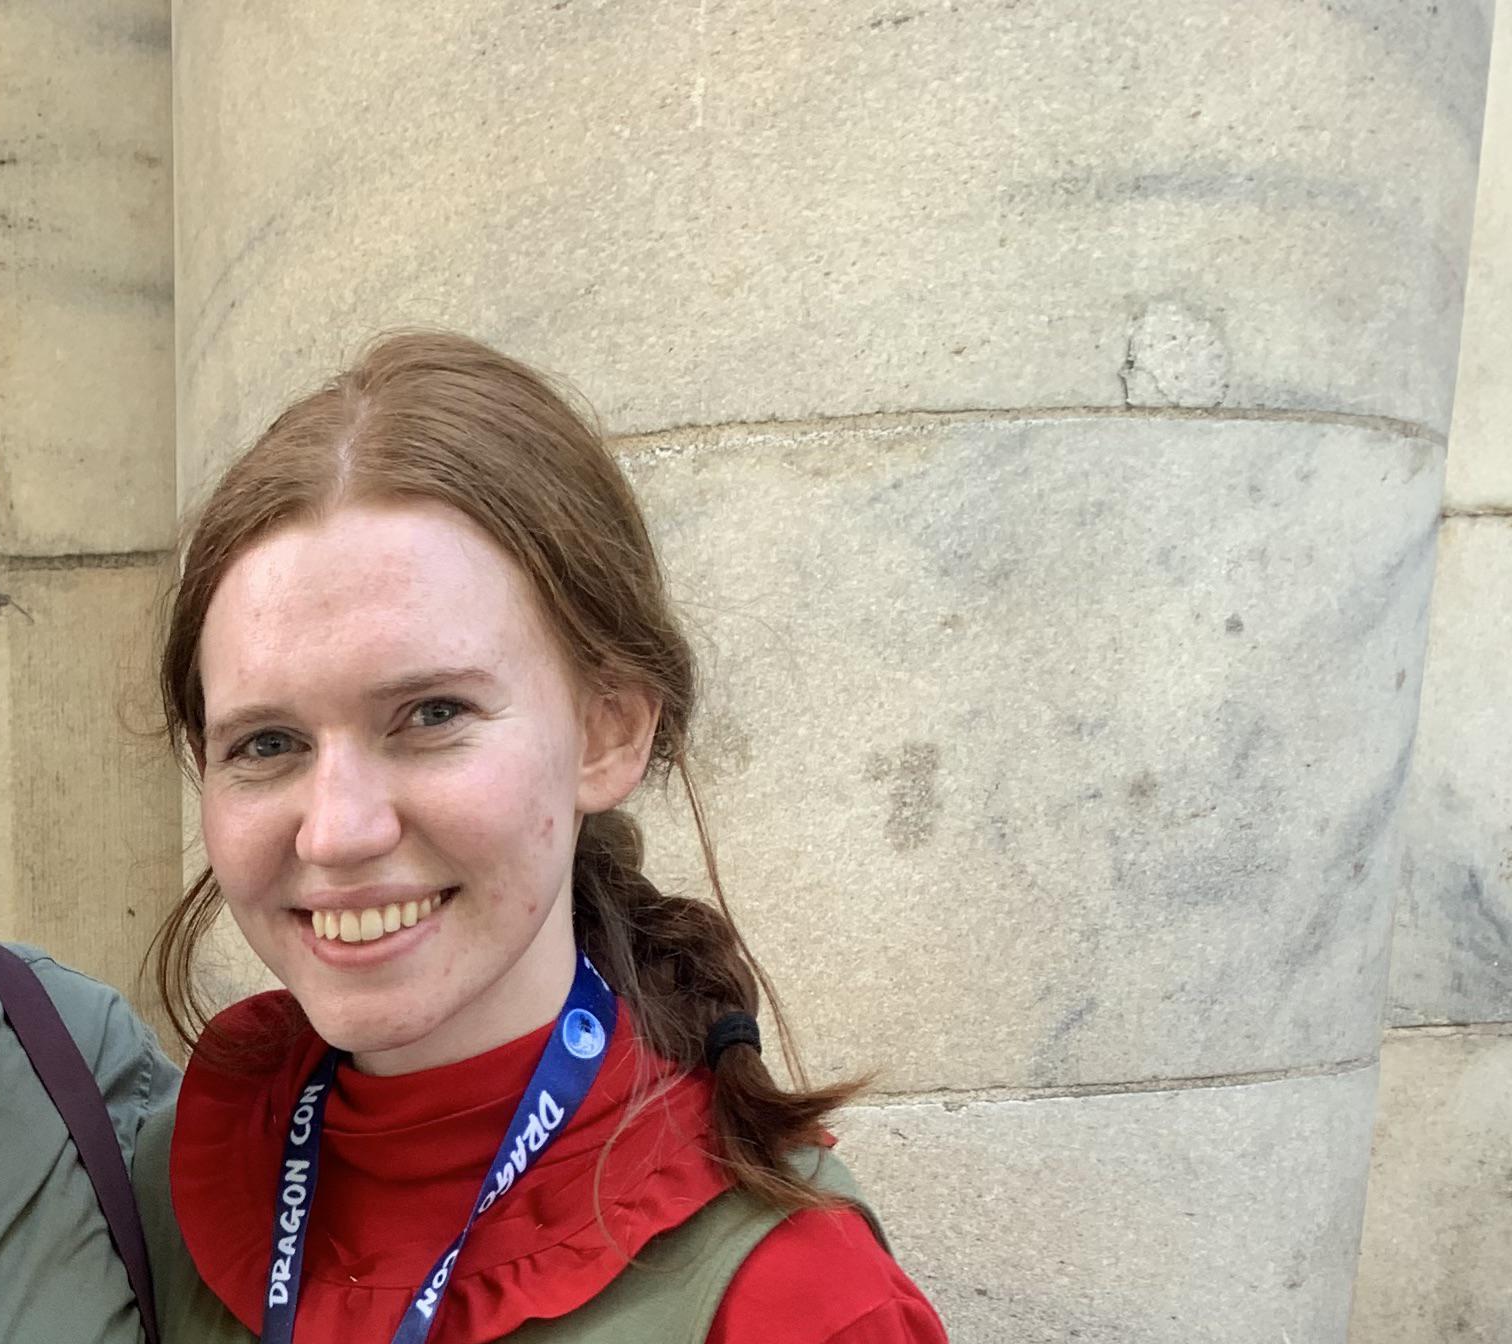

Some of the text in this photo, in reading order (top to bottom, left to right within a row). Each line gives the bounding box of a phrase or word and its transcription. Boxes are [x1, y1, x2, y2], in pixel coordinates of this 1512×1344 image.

[269, 1083, 325, 1308] DRAGON CON
[416, 1090, 566, 1319] DRAGO CON
